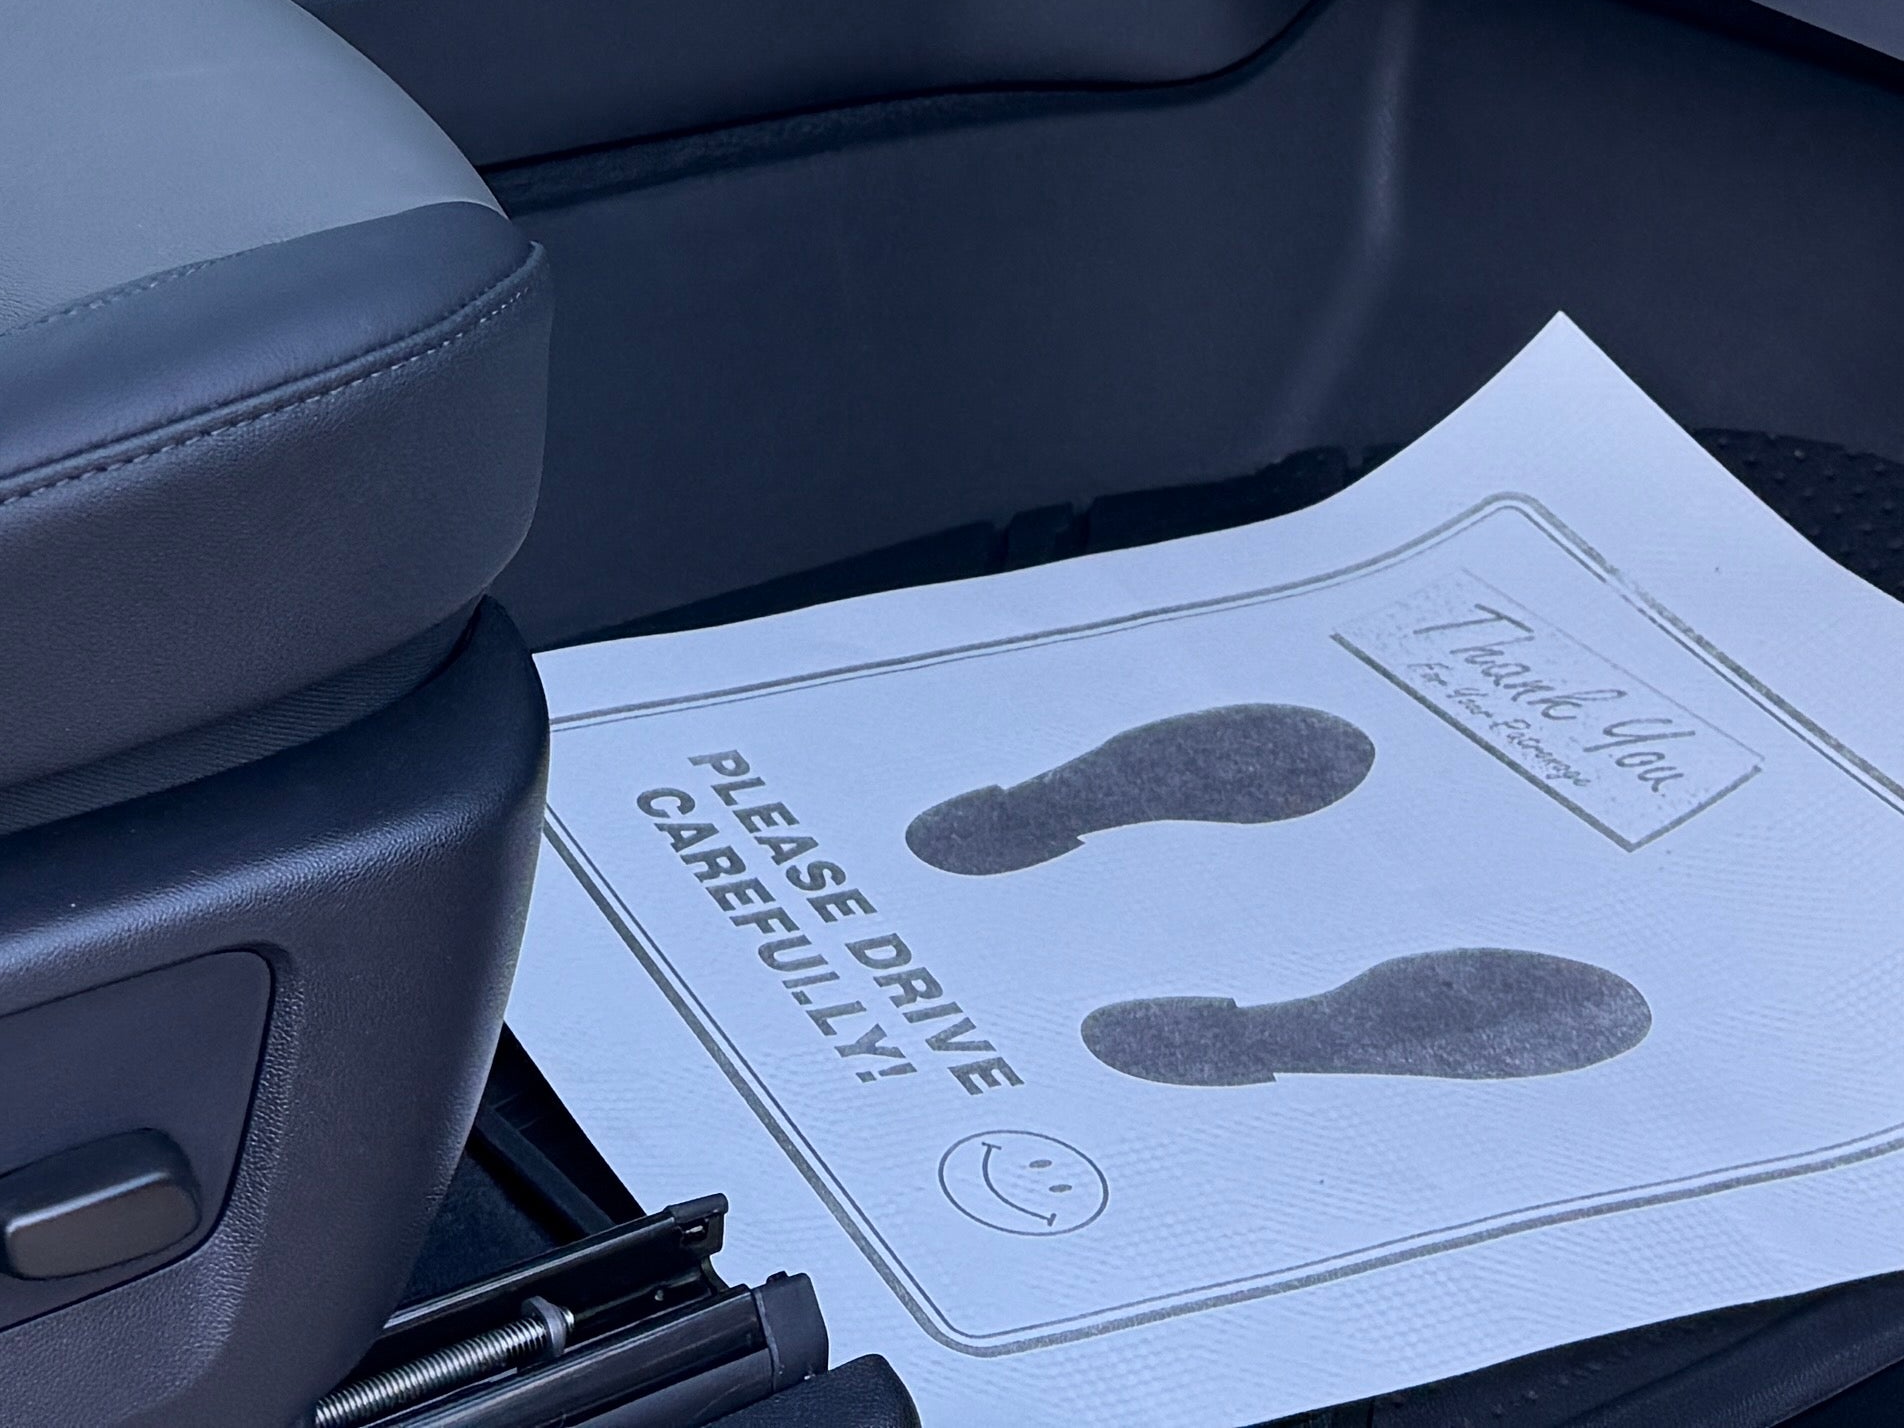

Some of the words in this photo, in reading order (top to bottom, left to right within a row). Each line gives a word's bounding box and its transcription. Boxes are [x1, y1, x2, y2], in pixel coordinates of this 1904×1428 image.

[1413, 604, 1627, 720] Thank
[1583, 718, 1696, 793] You
[636, 787, 918, 1083] CAREFULLY!
[688, 749, 877, 923] PLEASE
[845, 932, 1026, 1095] DRIVE
